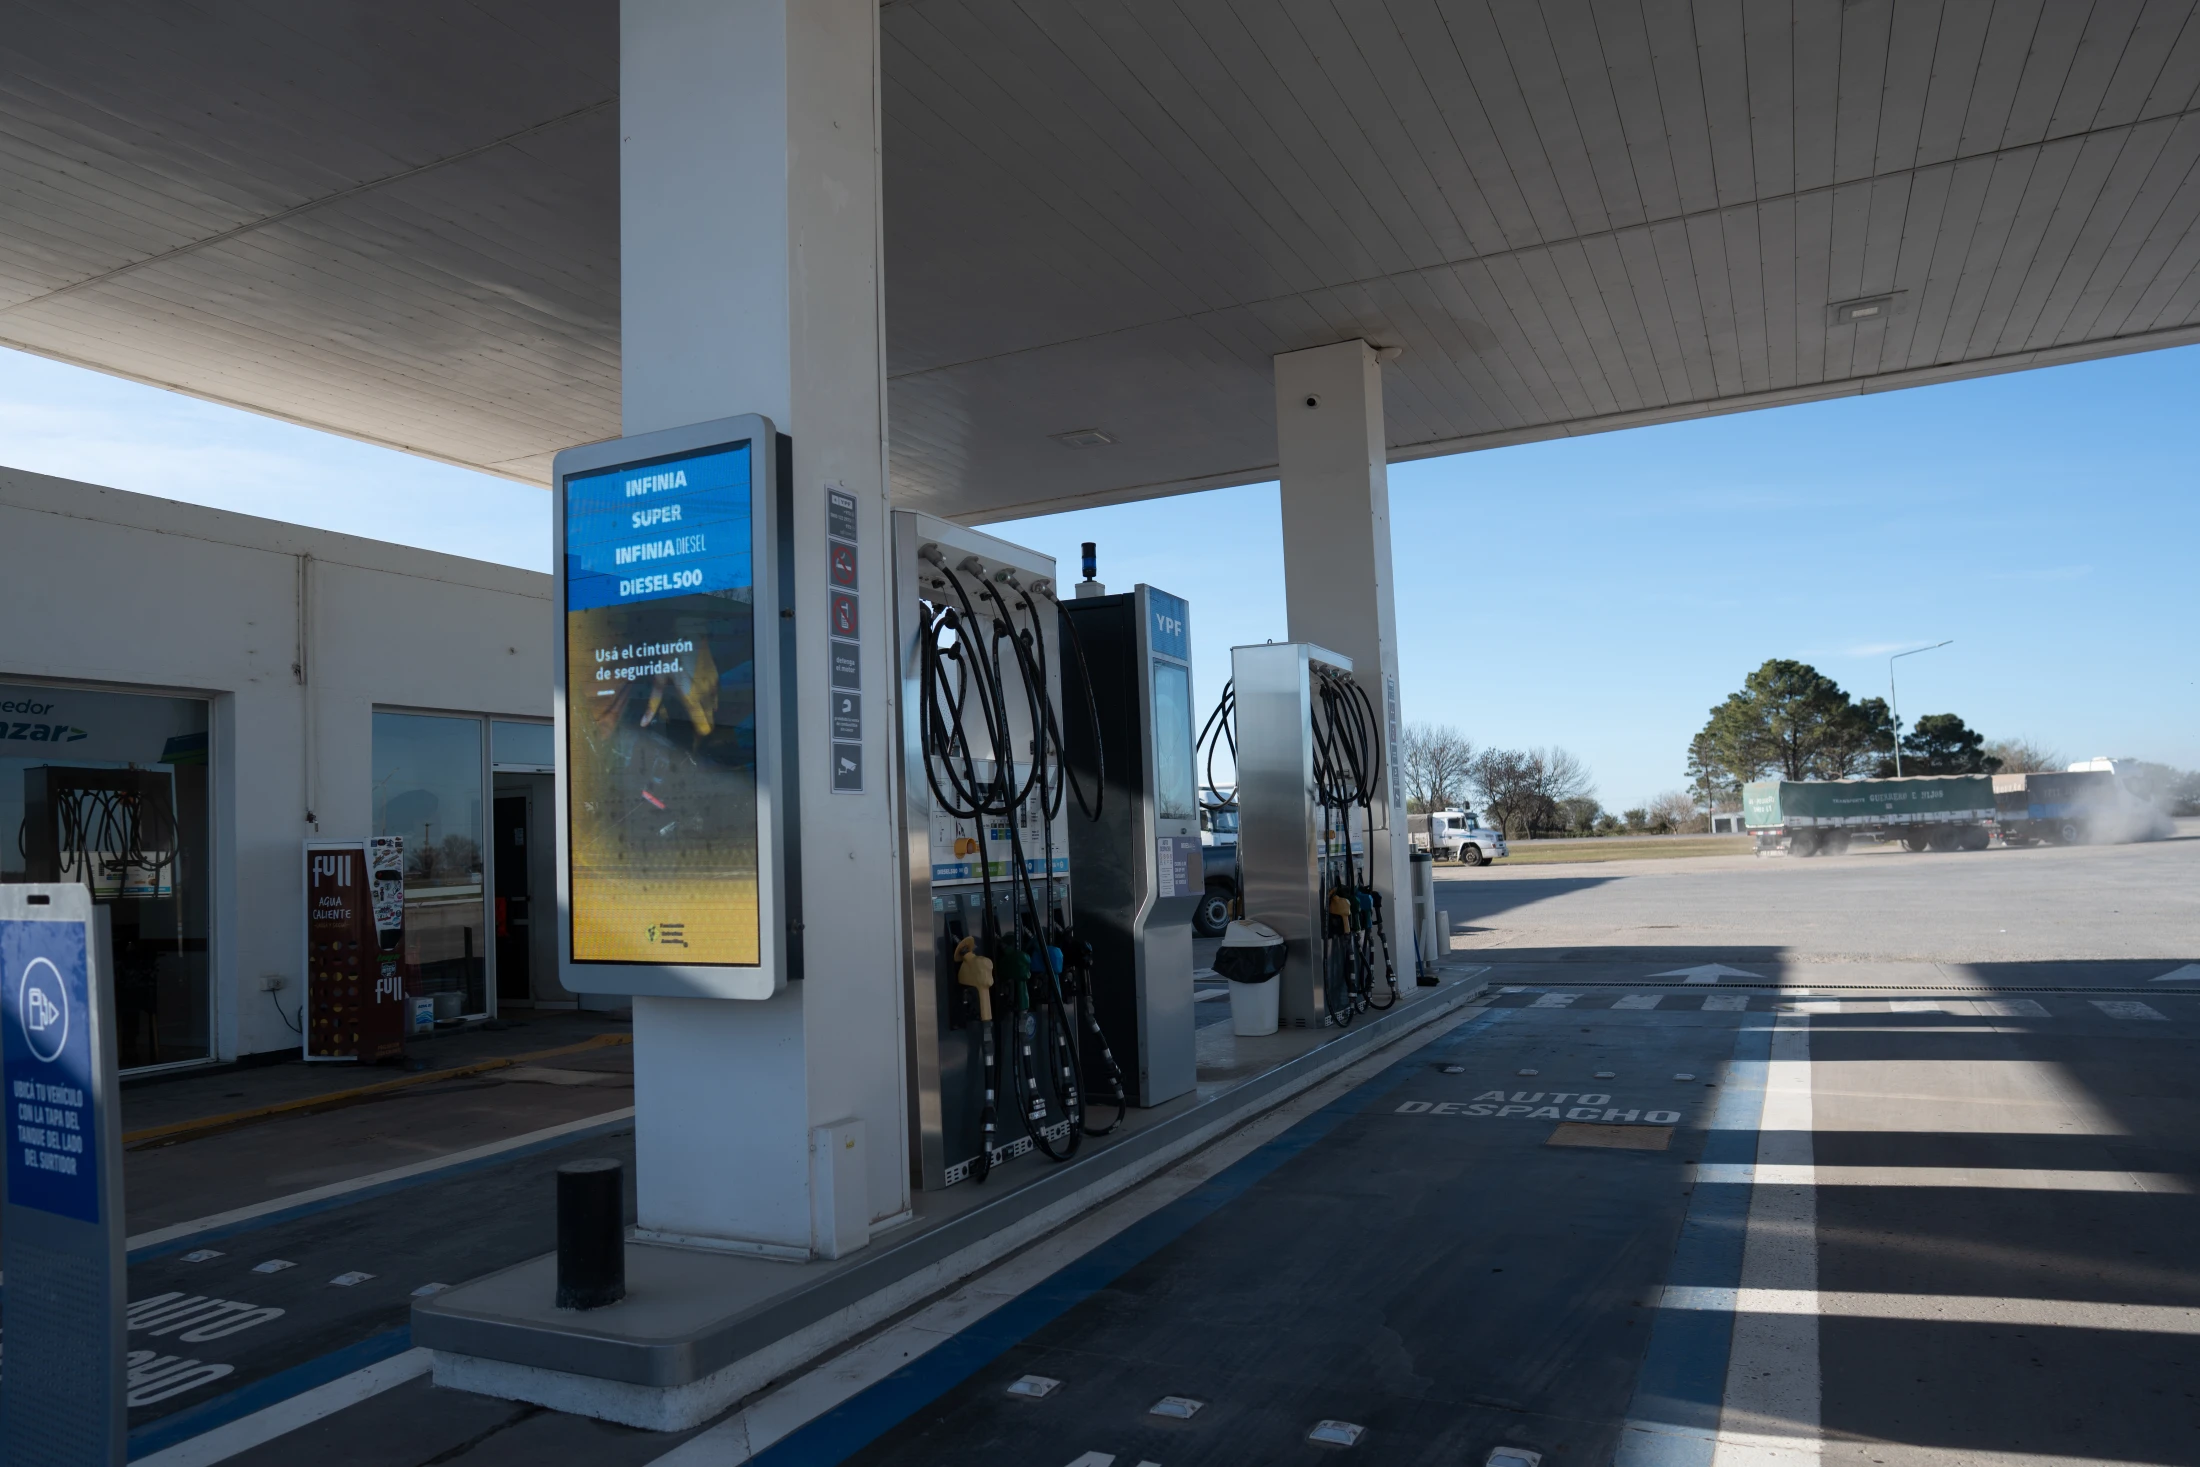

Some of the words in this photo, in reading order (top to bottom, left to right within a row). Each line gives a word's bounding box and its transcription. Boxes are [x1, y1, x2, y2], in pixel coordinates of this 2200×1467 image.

[626, 470, 687, 497] INFINIA
[632, 505, 682, 528] SUPER
[616, 540, 675, 565] INFINIA
[676, 534, 706, 555] DIESEL
[1156, 613, 1182, 637] YPF
[595, 644, 618, 662] Usá
[622, 642, 634, 659] el
[636, 638, 693, 657] cinturón
[836, 657, 855, 666] detenga
[596, 667, 611, 681] de
[614, 658, 683, 681] seguridad.
[0, 699, 54, 715] edor
[312, 855, 351, 888] full
[319, 896, 342, 907] AGUA
[312, 909, 351, 920] CALIENTE
[375, 976, 402, 1004] full
[35, 1082, 46, 1102] TU
[1472, 1090, 1611, 1105] AUTO
[18, 1103, 33, 1122] CON
[34, 1105, 44, 1124] LA
[44, 1106, 64, 1128] TAPA
[65, 1110, 80, 1131] DEL
[1394, 1101, 1681, 1123] DESPACHO
[17, 1124, 46, 1147] TANQUE
[46, 1130, 61, 1150] DEL
[62, 1132, 83, 1154] LADO
[24, 1148, 39, 1168] DEL
[39, 1151, 77, 1176] SURTIDOR
